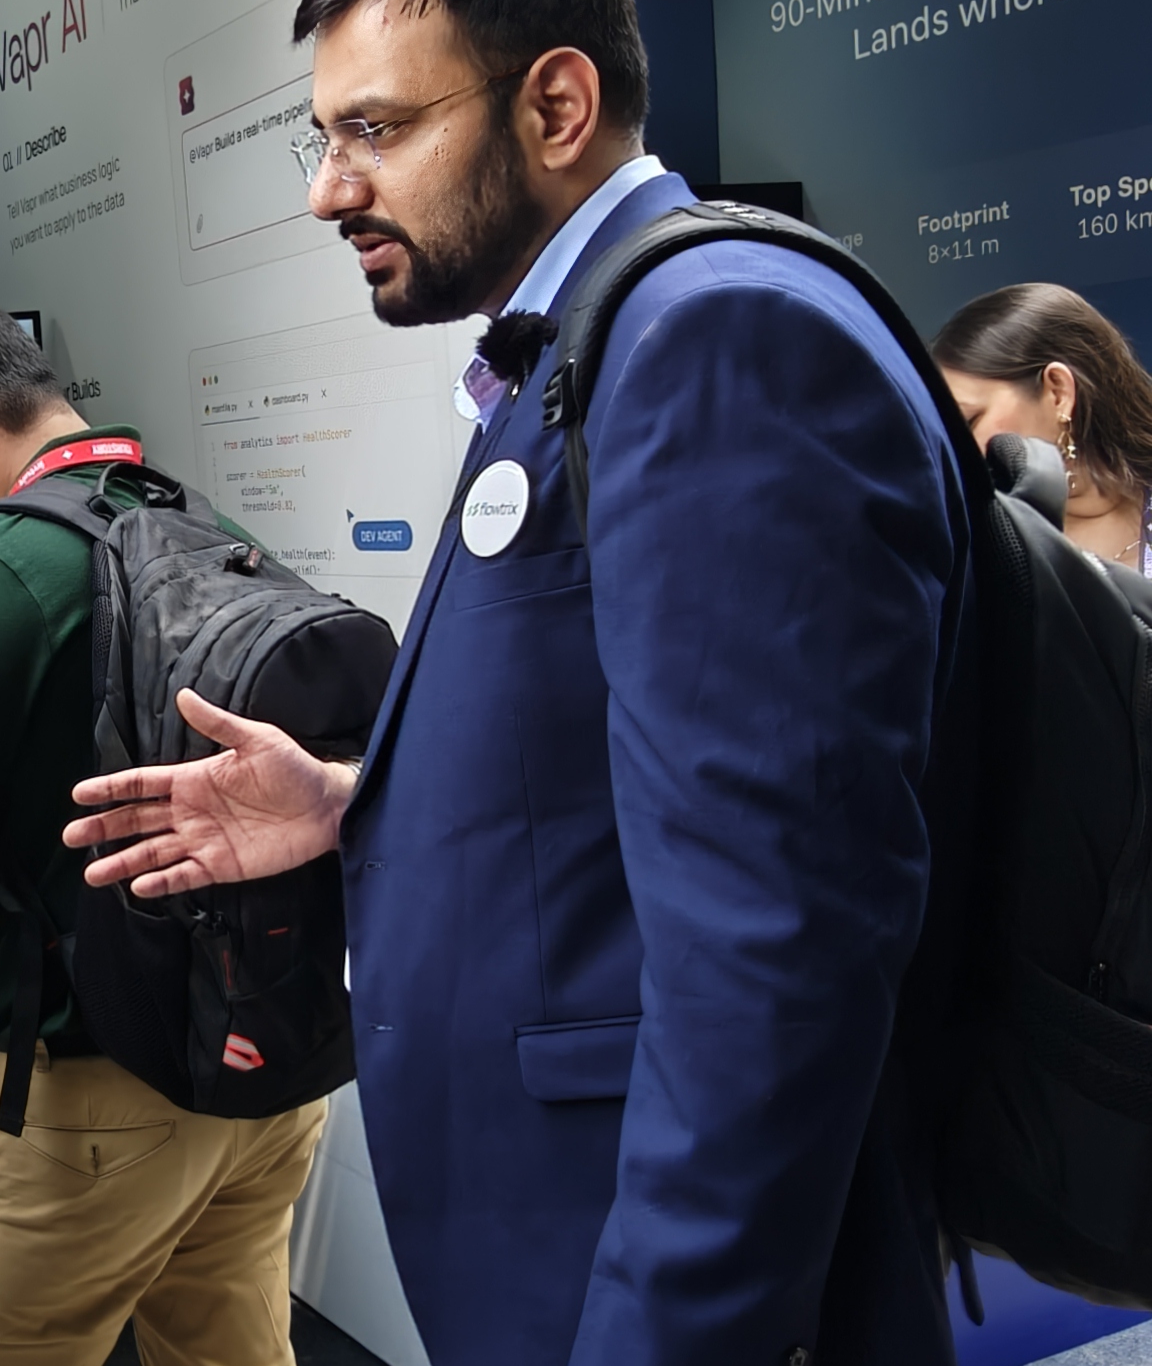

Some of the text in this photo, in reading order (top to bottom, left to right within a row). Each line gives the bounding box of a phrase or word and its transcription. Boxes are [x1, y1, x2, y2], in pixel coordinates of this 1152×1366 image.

[853, 5, 949, 61] Lands
[2, 151, 14, 172] 01
[24, 125, 67, 161] Describe
[189, 142, 214, 164] @Vapr
[214, 132, 236, 152] Build
[236, 133, 242, 143] a
[242, 112, 283, 140] real-time
[7, 155, 120, 220] Tell Vapr what business logic
[1069, 175, 1152, 208] Top Sp
[10, 191, 125, 256] you want to apply to the data
[917, 200, 1011, 236] Footprint
[1077, 212, 1118, 240] 160
[982, 237, 999, 255] m
[71, 377, 101, 401] Builds
[240, 437, 274, 451] analytics
[376, 529, 404, 543] AGENT
